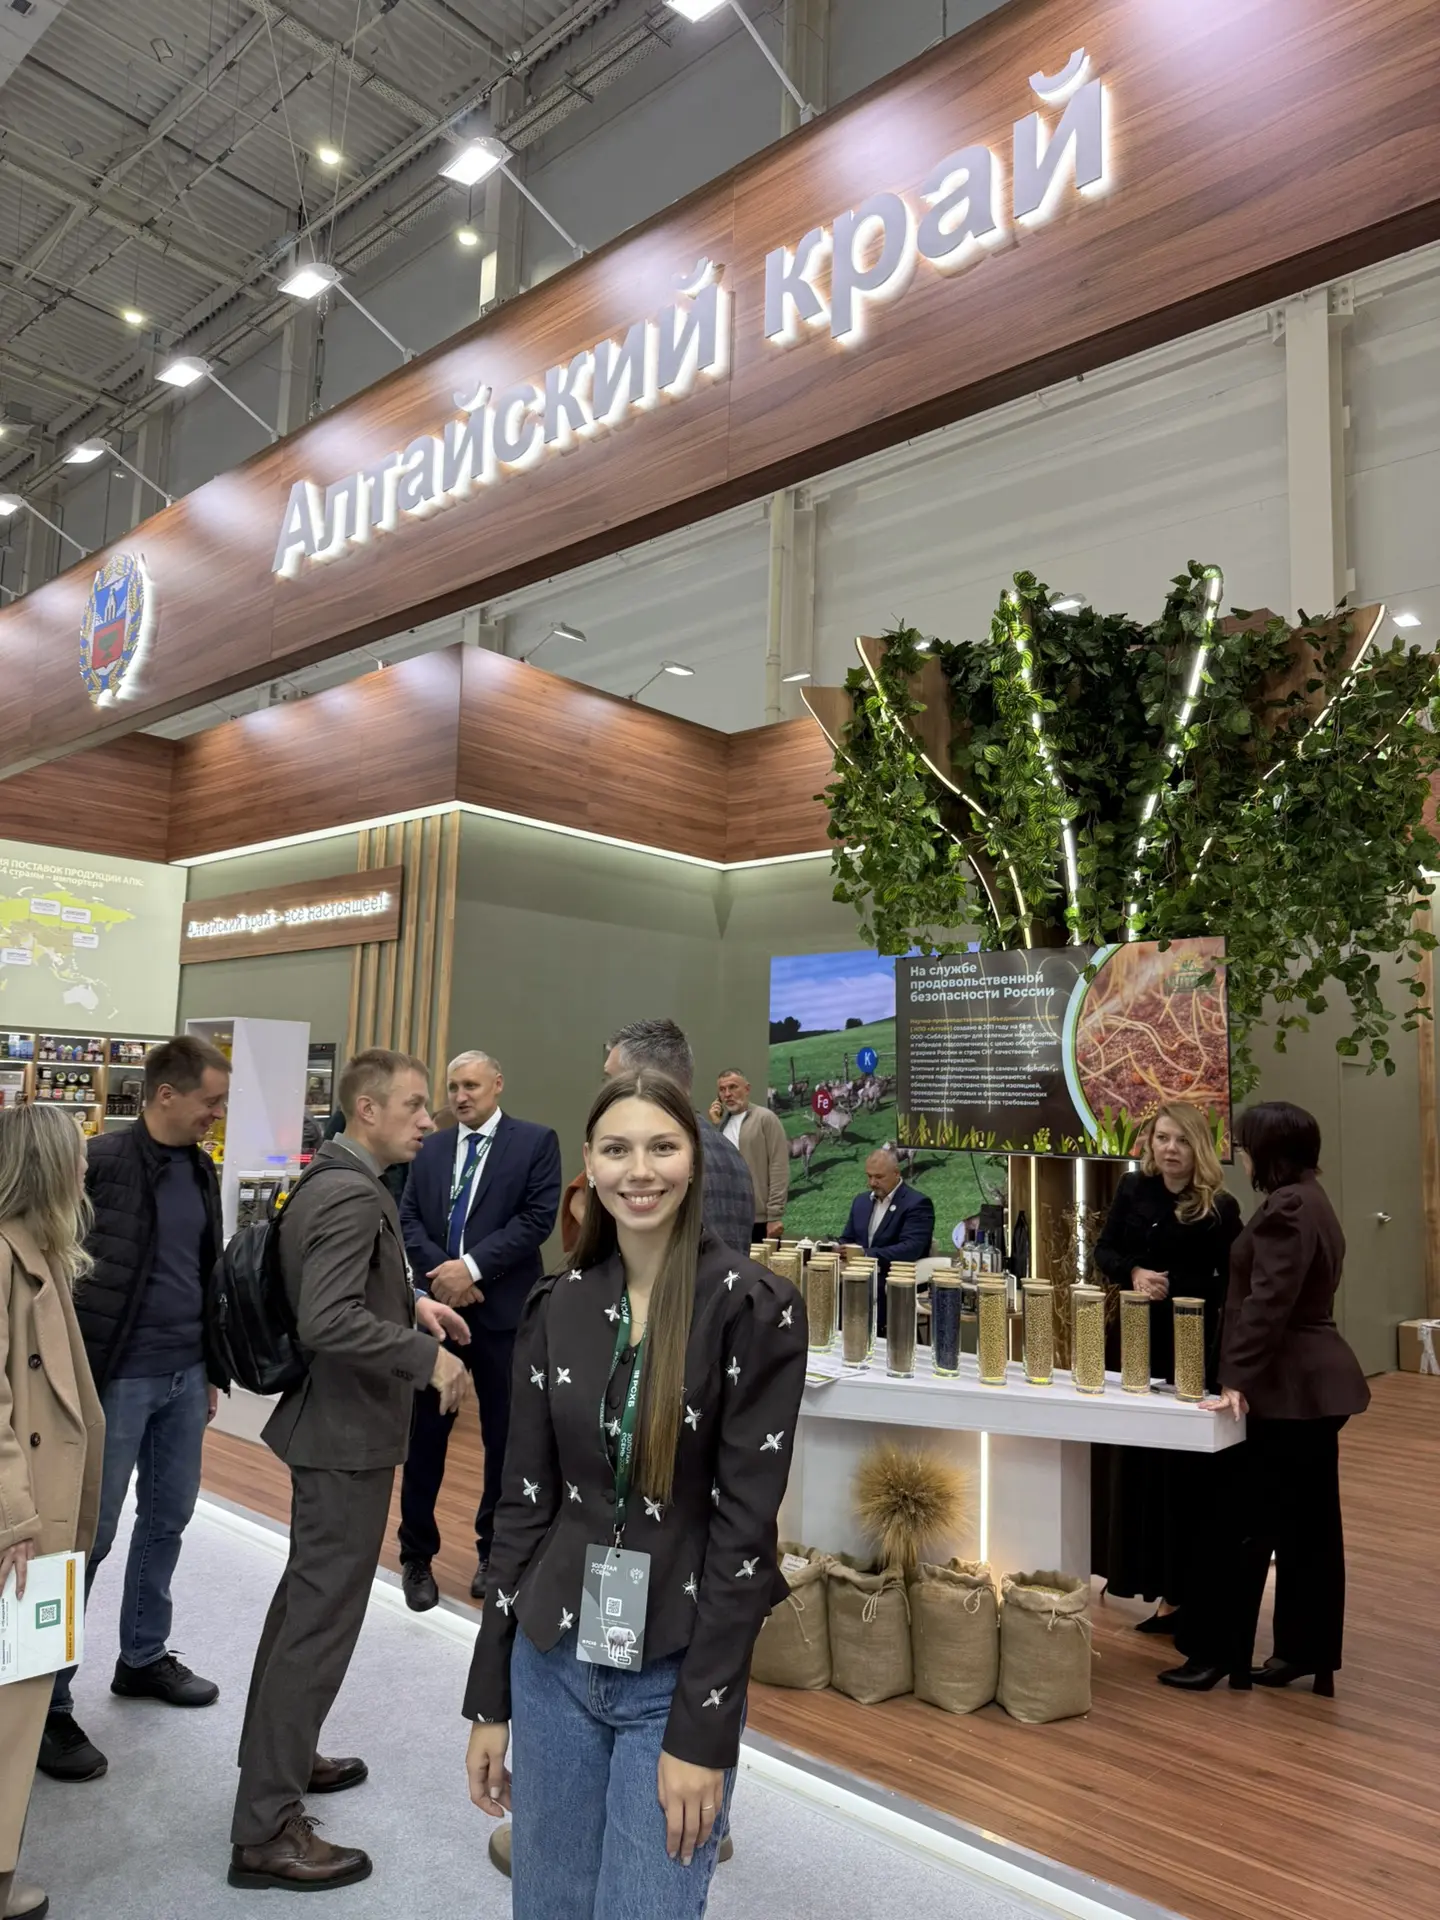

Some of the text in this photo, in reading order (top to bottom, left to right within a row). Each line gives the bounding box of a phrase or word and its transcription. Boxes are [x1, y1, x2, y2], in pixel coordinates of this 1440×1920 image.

[272, 46, 1106, 577] Алтайский край
[9, 868, 44, 880] страны
[53, 874, 103, 888] импортера
[11, 859, 63, 874] ПОСТАВОК
[64, 867, 122, 884] ПРОДУКЦИИ
[187, 914, 244, 938] Алтайский
[245, 909, 275, 934] край
[284, 907, 306, 923] все
[308, 892, 388, 920] настоящее!
[910, 961, 978, 977] На службе
[910, 971, 1045, 991] продовольственной
[910, 986, 1056, 1003] безопасности России
[817, 1093, 829, 1109] Fe
[627, 1379, 639, 1408] РСХБ
